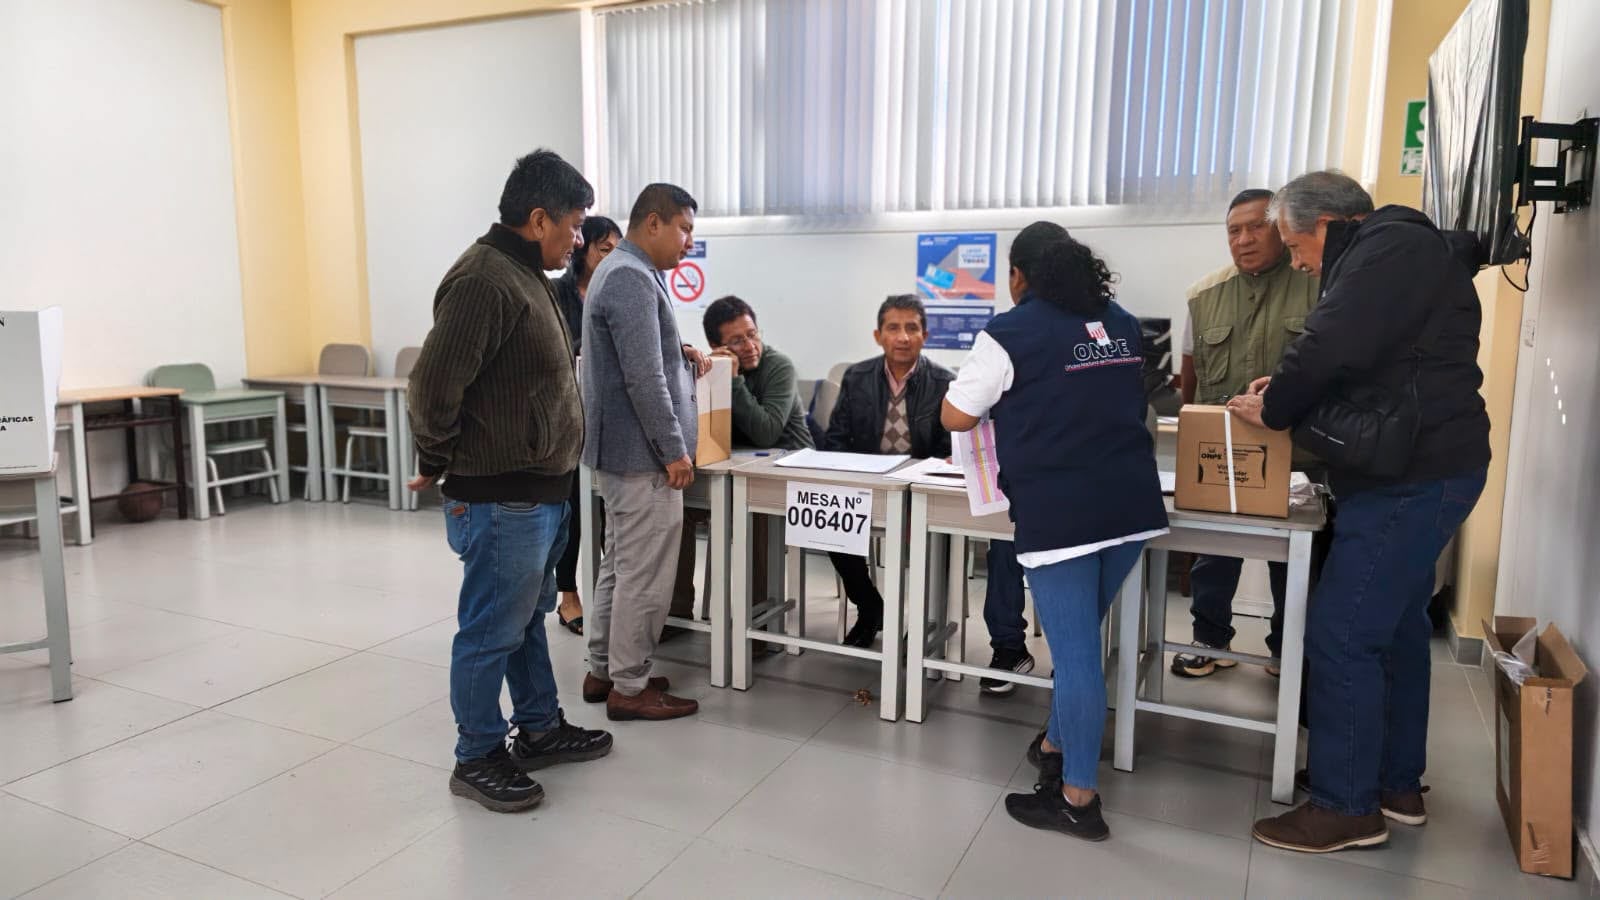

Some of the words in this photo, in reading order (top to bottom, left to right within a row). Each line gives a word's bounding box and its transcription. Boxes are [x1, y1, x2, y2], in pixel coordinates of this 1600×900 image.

[1073, 339, 1131, 361] ONPE
[798, 490, 841, 508] MESA
[845, 496, 862, 510] Nº
[788, 506, 868, 534] 006407
